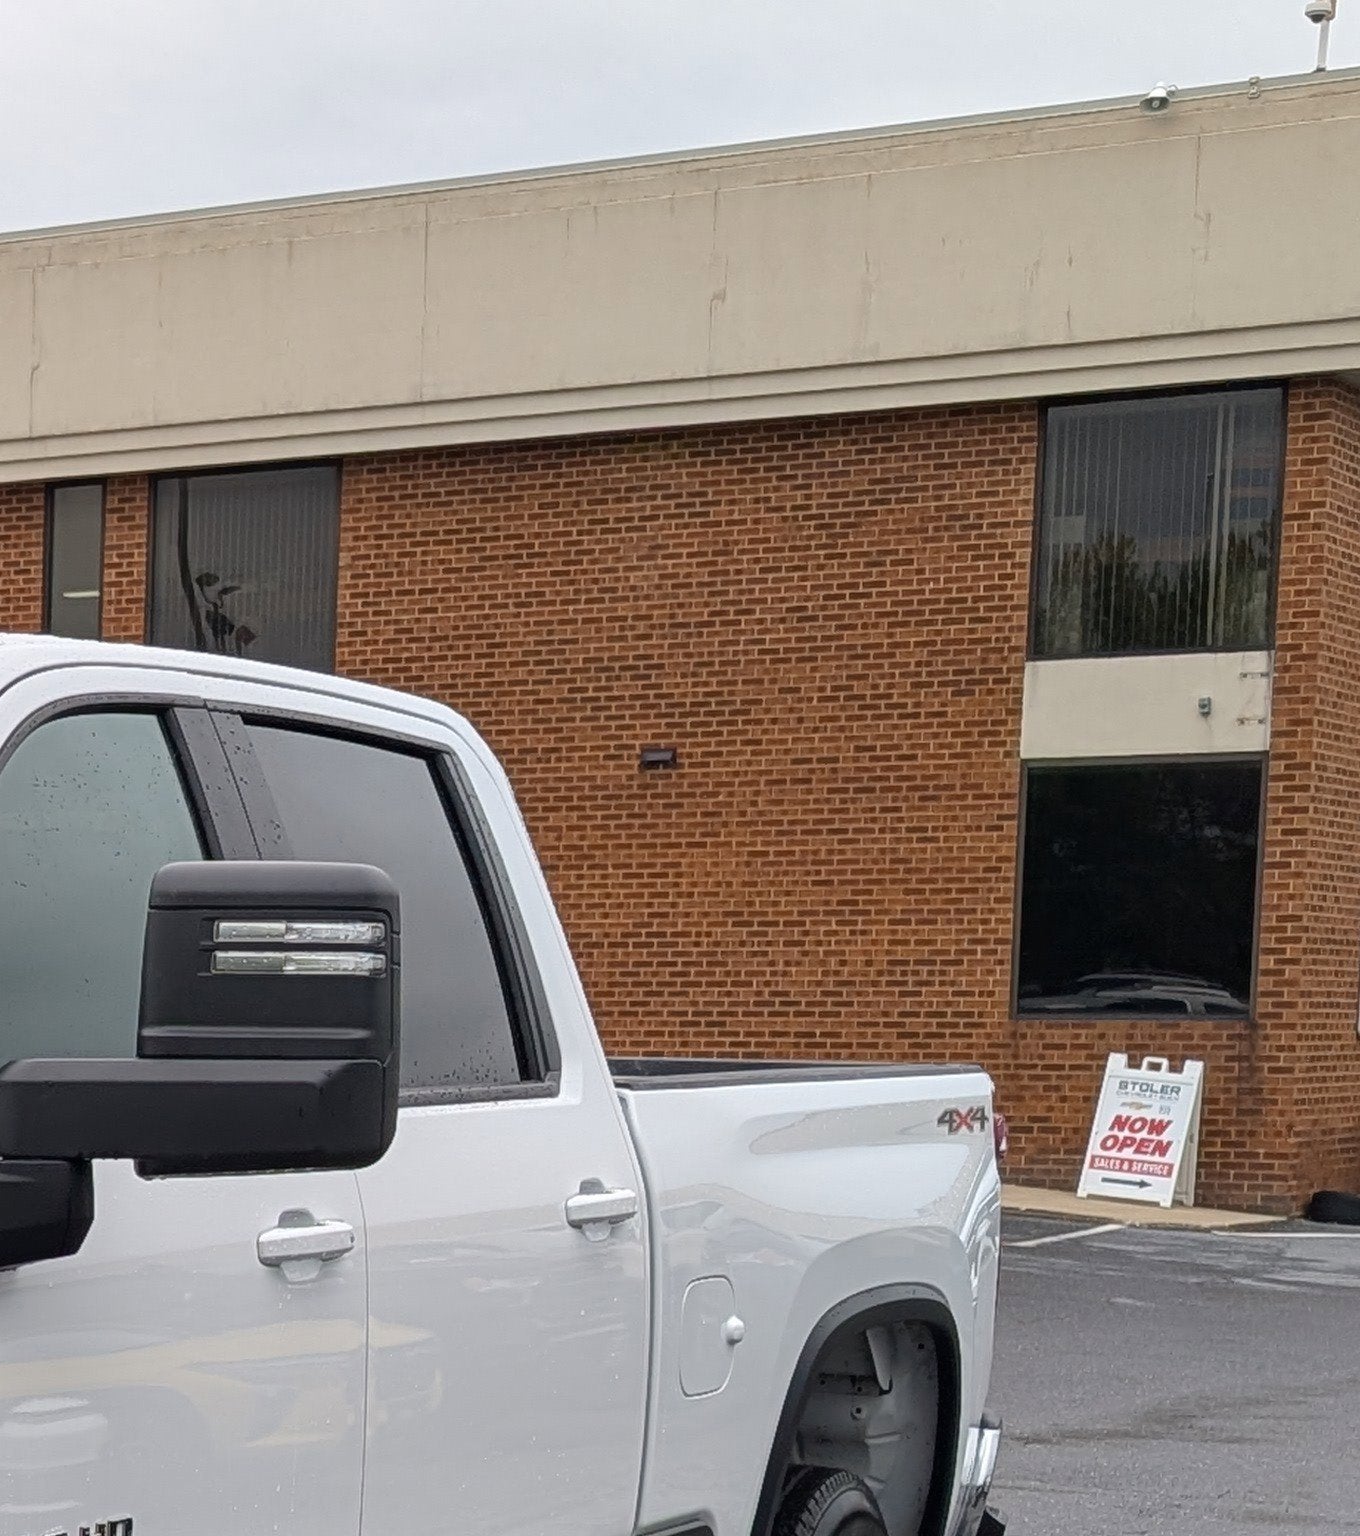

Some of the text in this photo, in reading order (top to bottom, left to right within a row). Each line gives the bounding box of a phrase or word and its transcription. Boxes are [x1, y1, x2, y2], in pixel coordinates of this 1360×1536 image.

[1118, 1080, 1182, 1096] STOLER
[1108, 1114, 1173, 1136] NOW
[1100, 1135, 1174, 1158] OPEN
[1094, 1158, 1120, 1170] SALES
[1132, 1161, 1170, 1175] SERVICE
